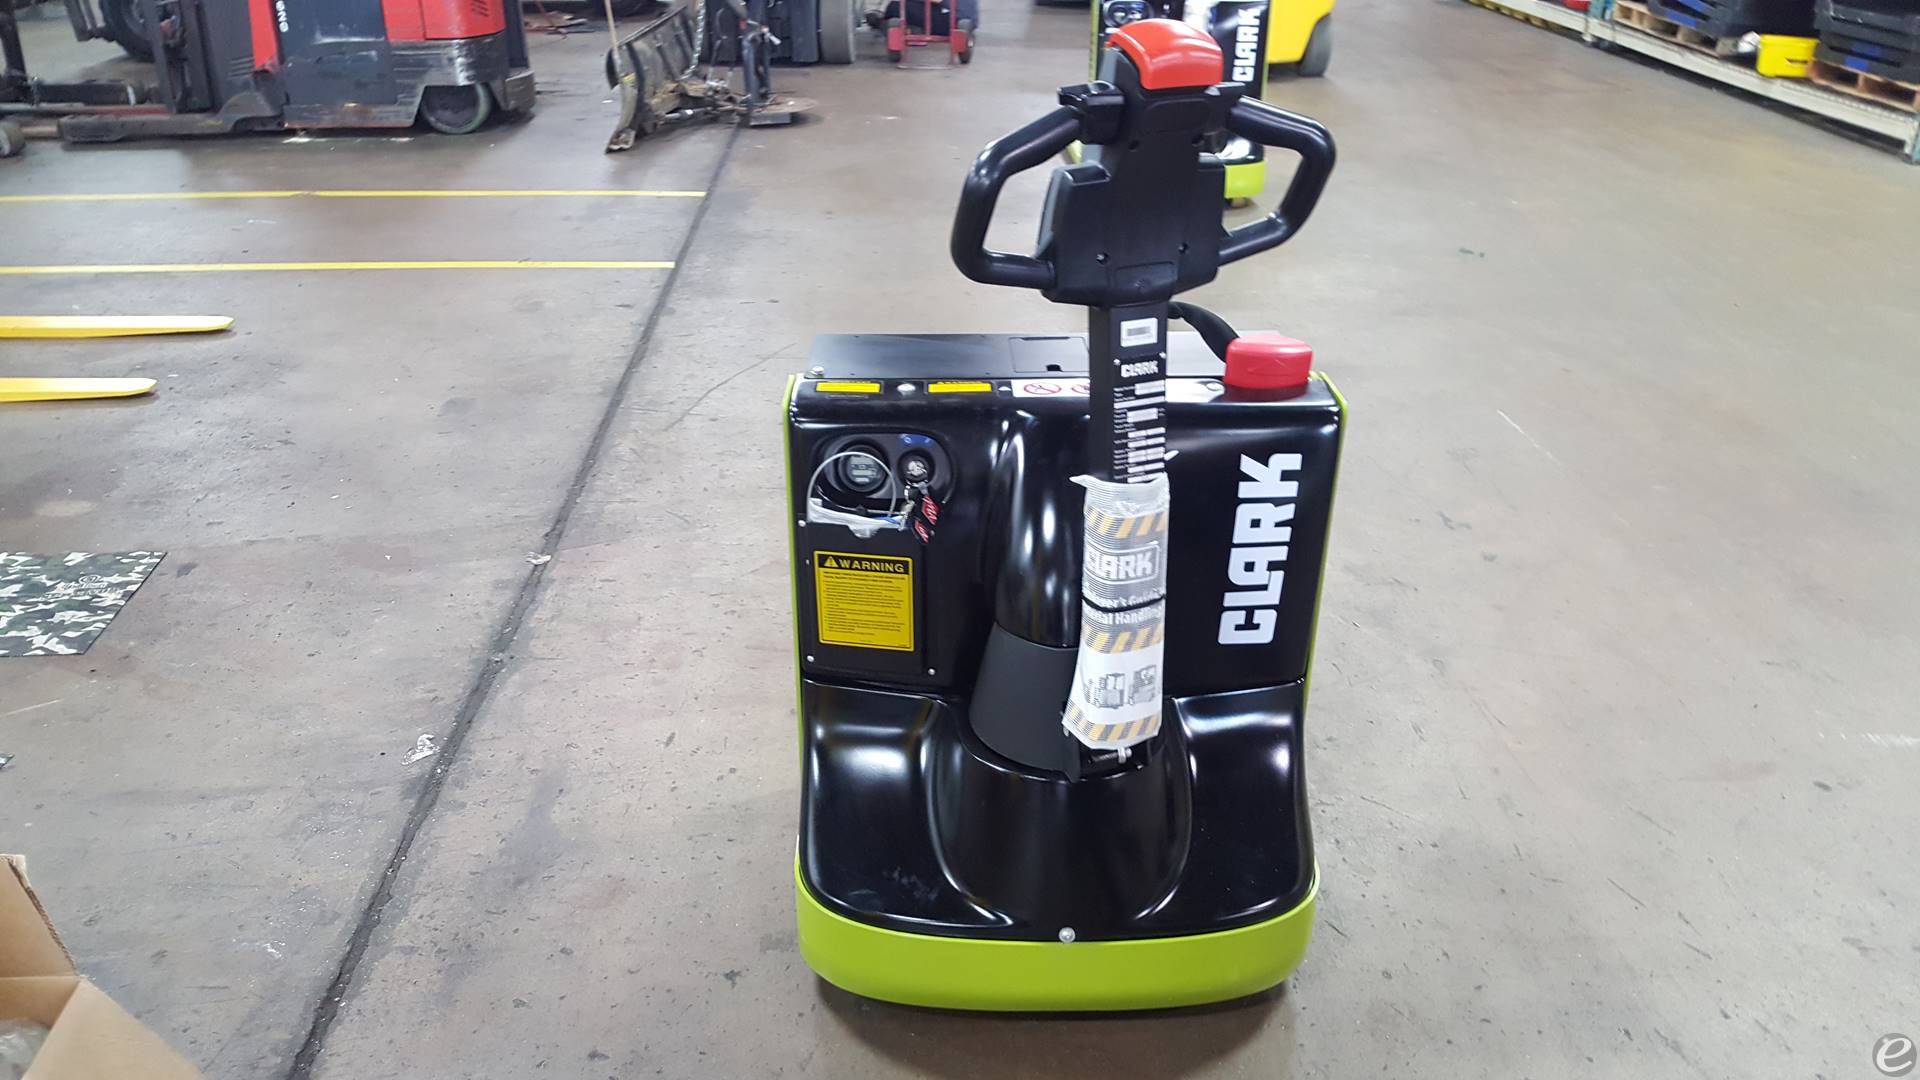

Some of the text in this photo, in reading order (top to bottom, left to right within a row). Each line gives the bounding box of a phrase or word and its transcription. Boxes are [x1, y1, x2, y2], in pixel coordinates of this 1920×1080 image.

[1232, 8, 1260, 82] CLARK
[1121, 360, 1158, 378] CLARK
[838, 558, 905, 573] WARNING
[1218, 453, 1303, 645] CLARK
